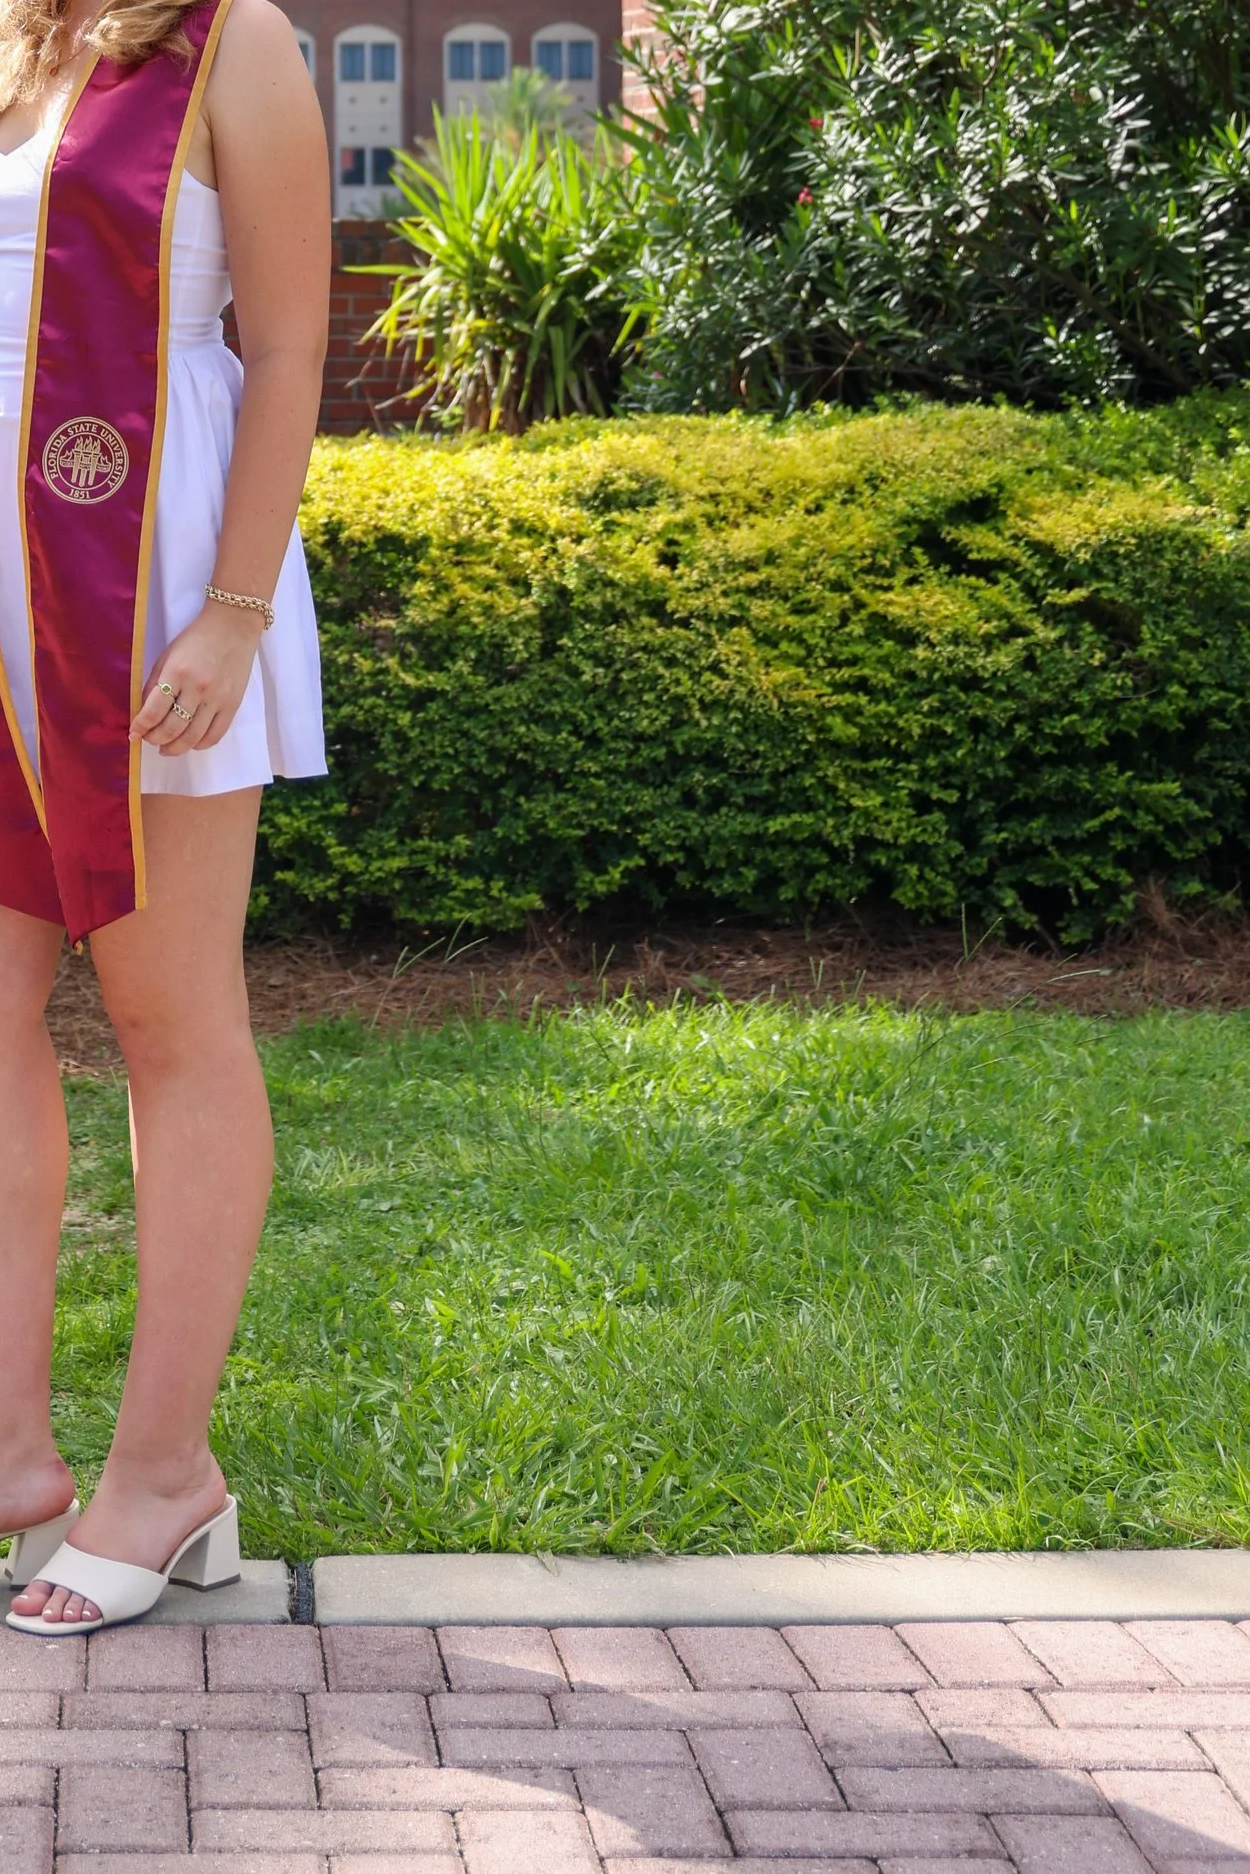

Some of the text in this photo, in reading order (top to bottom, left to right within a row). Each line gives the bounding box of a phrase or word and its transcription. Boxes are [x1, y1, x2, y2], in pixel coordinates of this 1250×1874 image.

[48, 422, 124, 489] FLORIDA STATE UNIVERSITY
[68, 488, 91, 500] 1851
